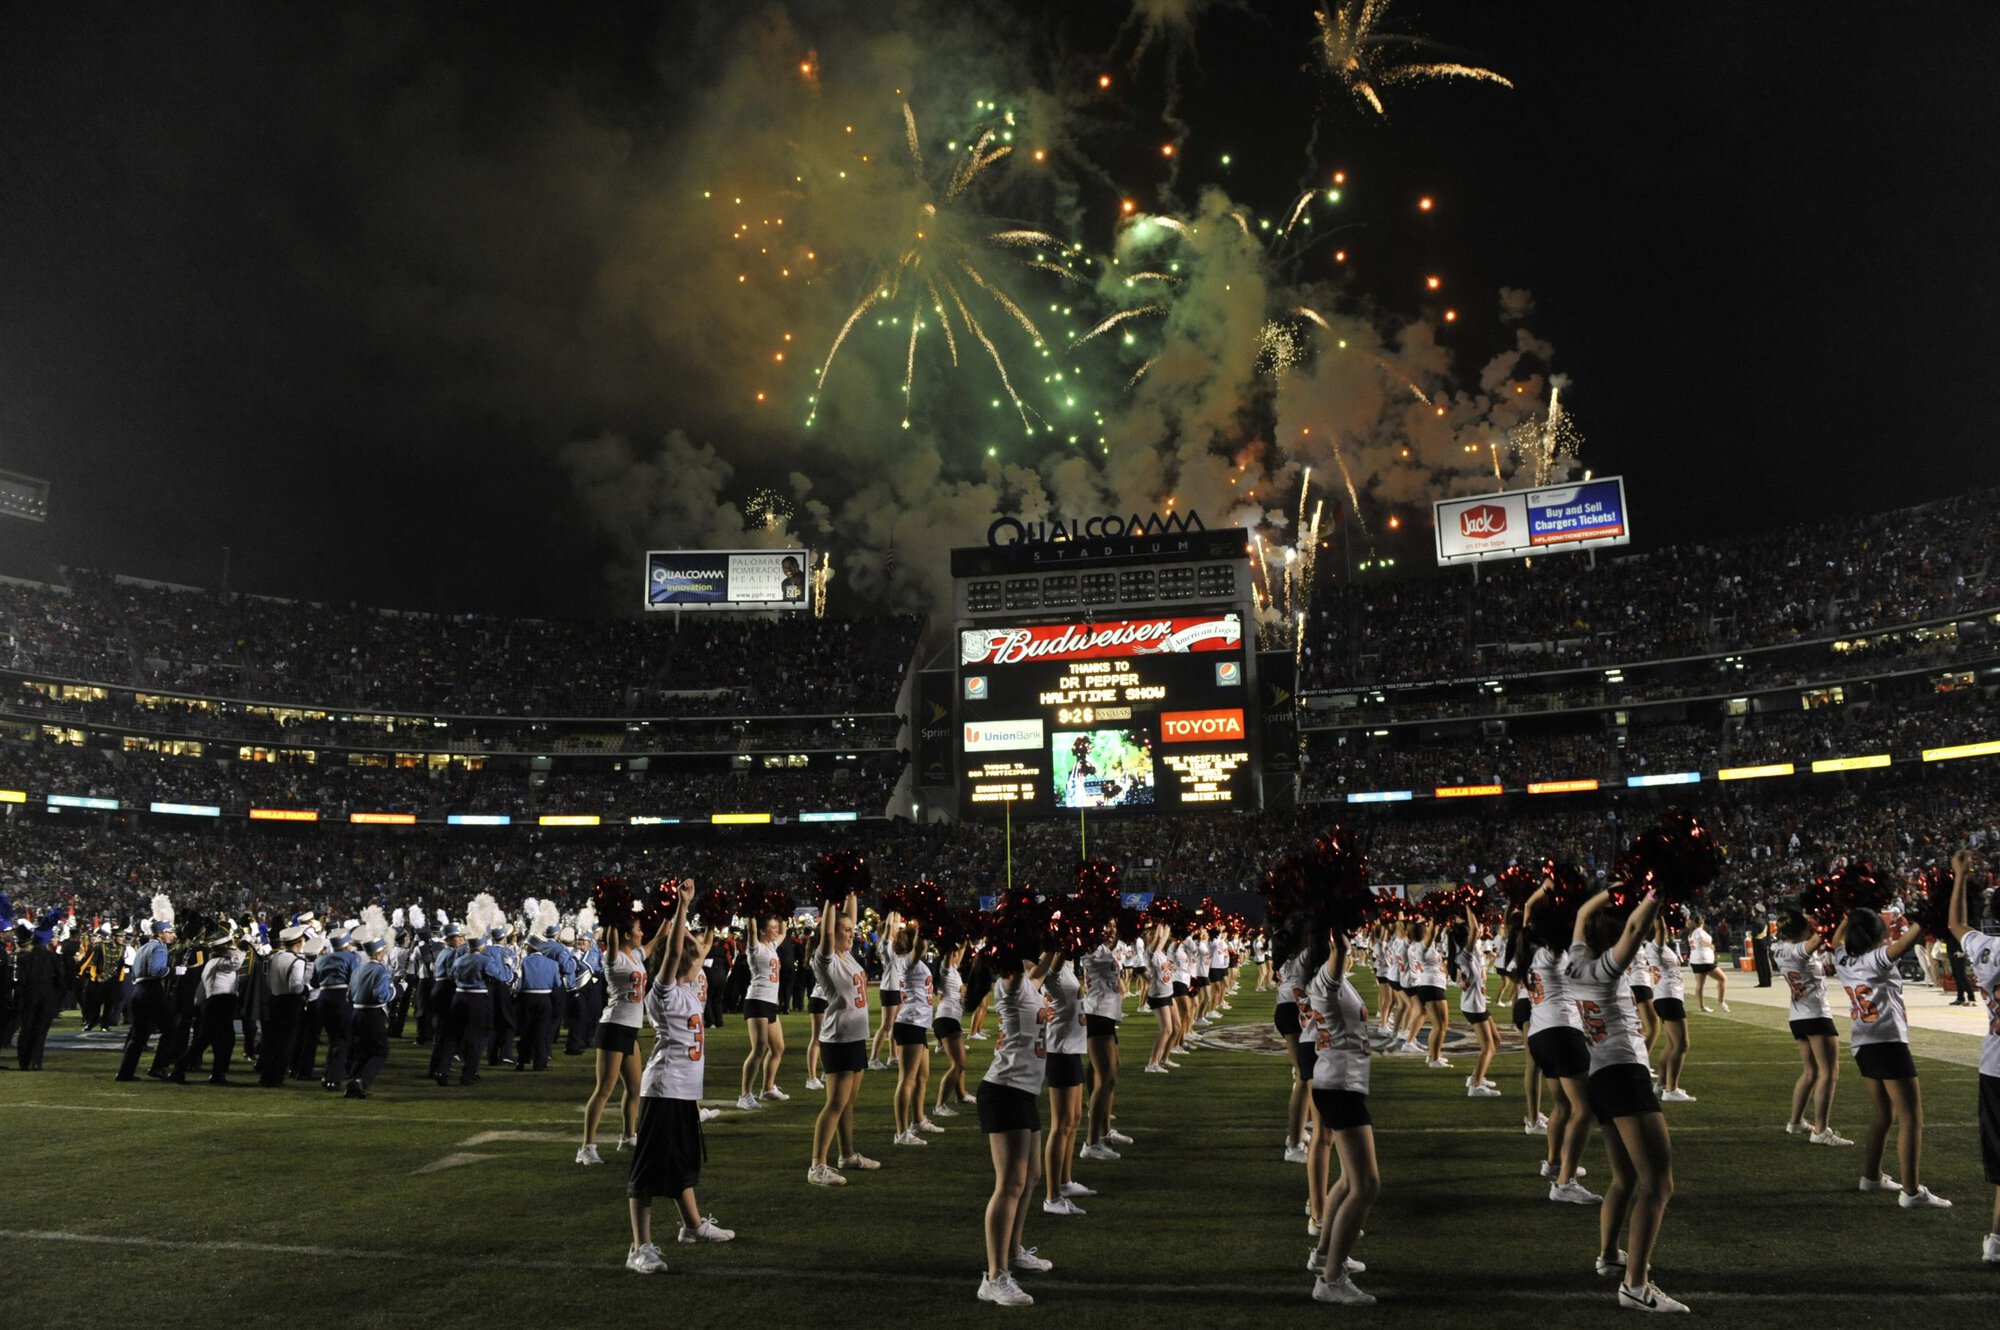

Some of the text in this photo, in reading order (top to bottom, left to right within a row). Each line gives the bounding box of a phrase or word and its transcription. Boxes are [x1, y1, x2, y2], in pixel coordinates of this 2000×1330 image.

[1546, 502, 1602, 518] Buy and Sell
[1463, 508, 1505, 535] Jack
[1535, 512, 1616, 530] Chargers Tickets!
[987, 509, 1206, 561] QUALCOMM
[1033, 541, 1189, 561] STADIUM
[731, 558, 780, 566] PALOMAR
[653, 568, 724, 584] QUALCOMM
[731, 575, 780, 583] HEALTH
[667, 584, 712, 592] Innovation
[987, 620, 1172, 664] Budweiser
[1174, 626, 1237, 646] American Lager
[1069, 661, 1130, 674] THANKS TO
[1059, 673, 1139, 689] DR PEPPER
[1040, 686, 1166, 704] HALFTIME SHOW
[1058, 707, 1094, 723] 9:26
[921, 727, 950, 740] Sprint
[1165, 717, 1241, 735] TOYOTA
[1183, 754, 1222, 763] PACIFIC
[1224, 752, 1249, 762] LIFE
[1437, 785, 1501, 796] WELLS FARGO
